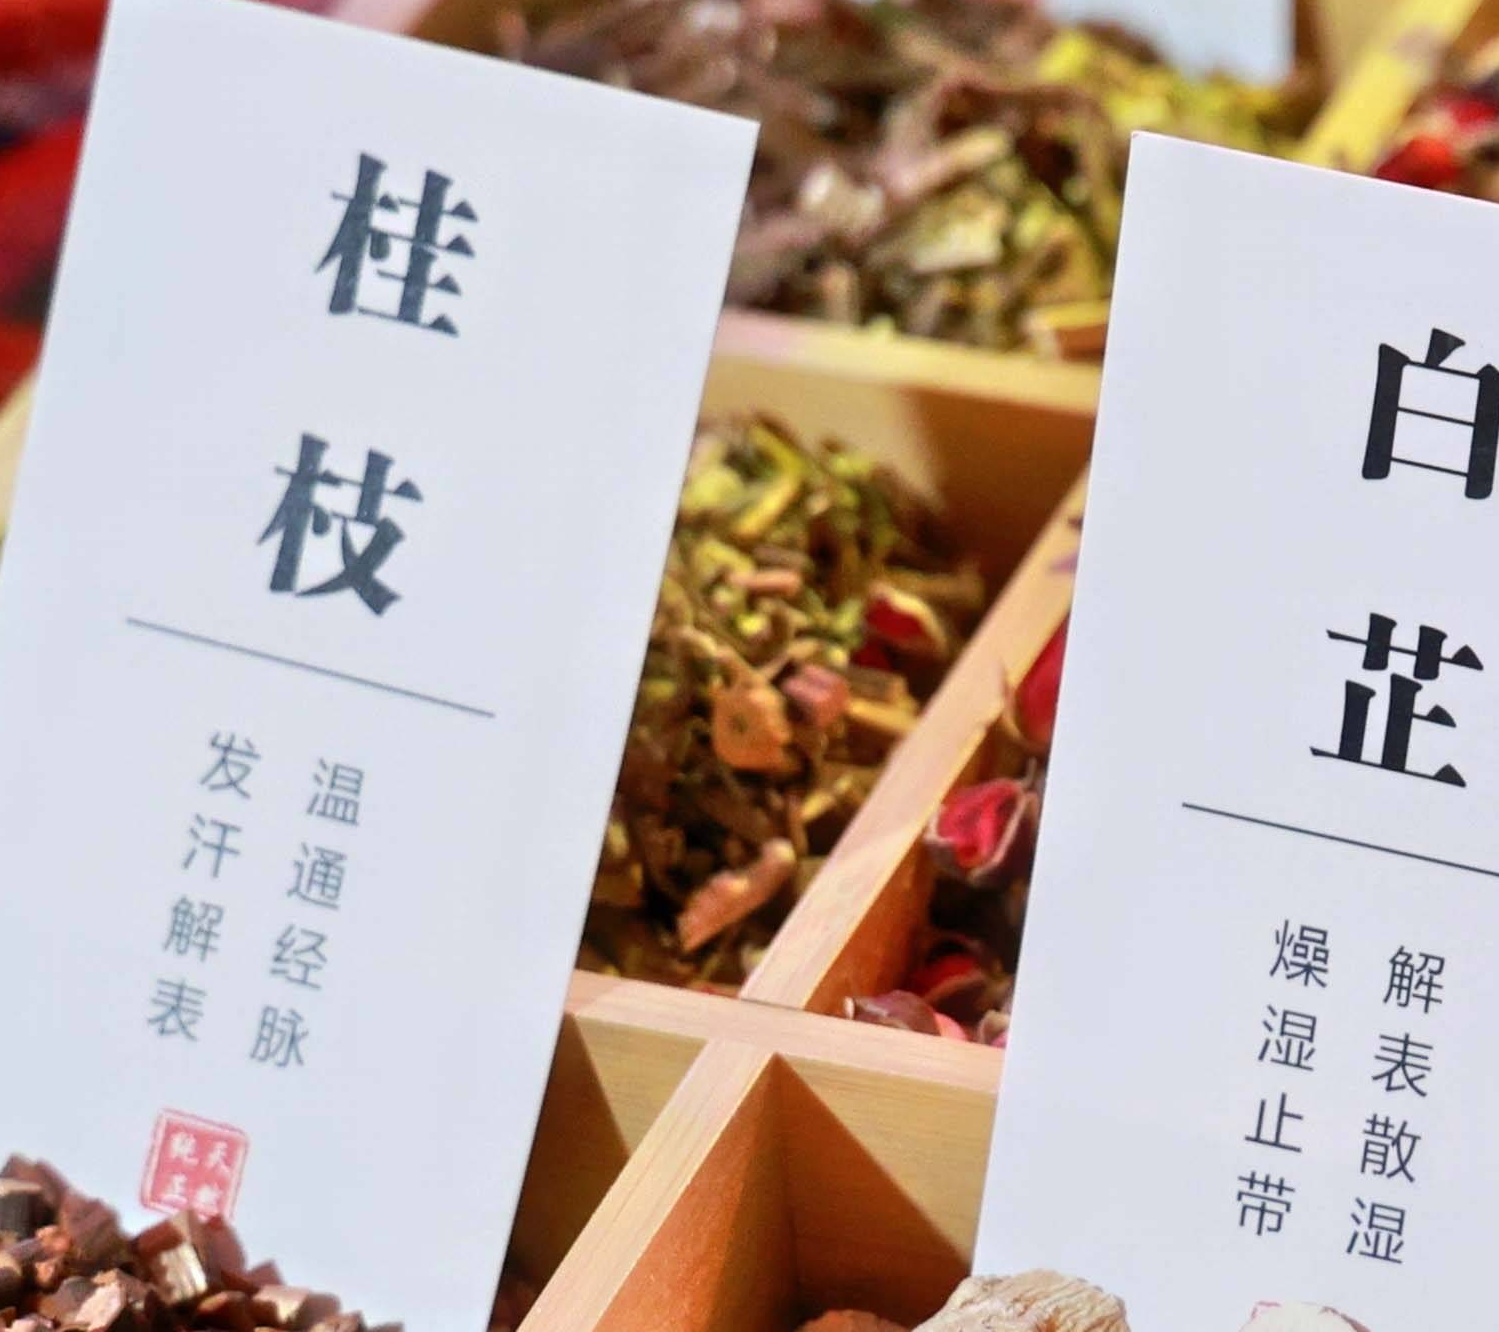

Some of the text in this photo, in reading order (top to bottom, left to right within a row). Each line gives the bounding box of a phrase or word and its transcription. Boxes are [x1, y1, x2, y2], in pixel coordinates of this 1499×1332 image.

[259, 153, 477, 616] 桂枝
[148, 733, 260, 1040] 发汗解表
[250, 759, 363, 1067] 温通经脉
[1237, 919, 1329, 1236] 燥湿止带
[1346, 945, 1445, 1264] 解表散湿
